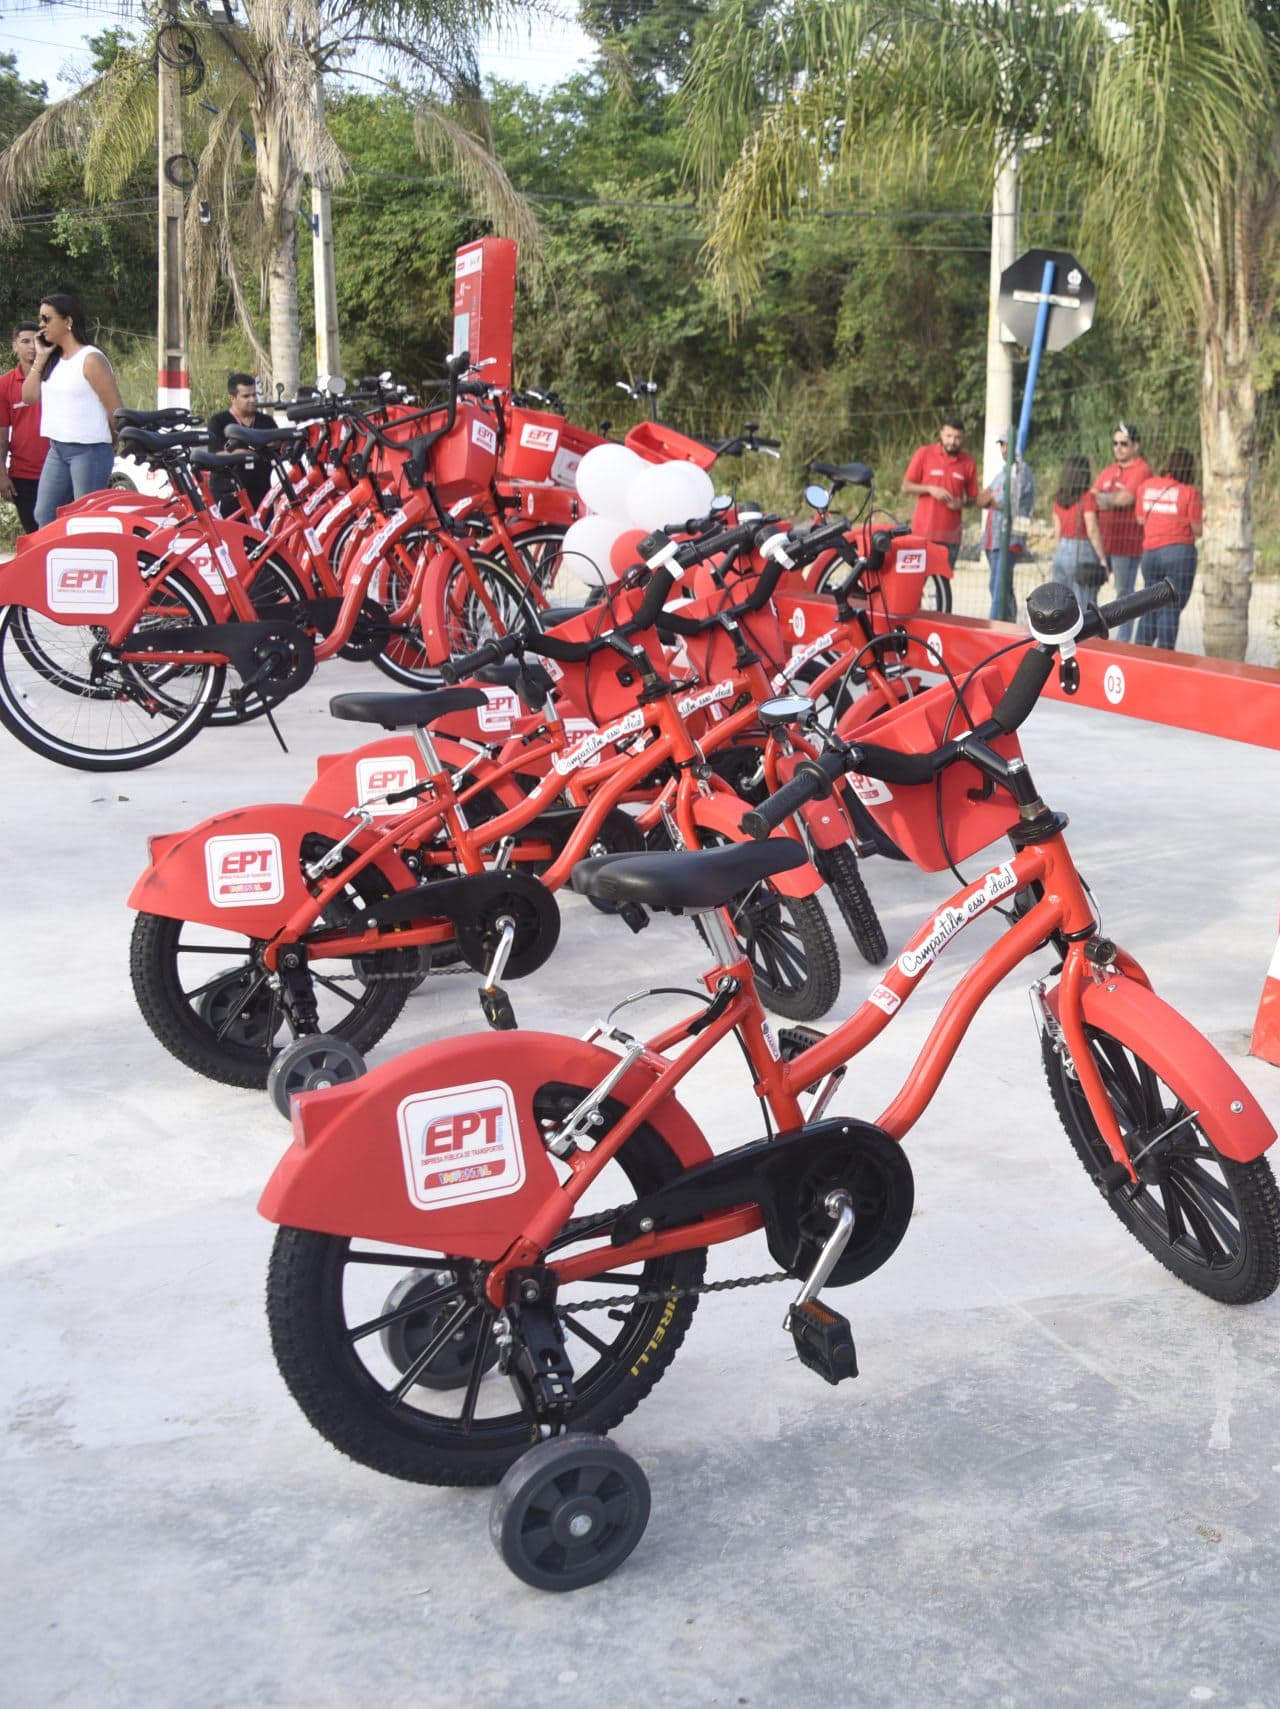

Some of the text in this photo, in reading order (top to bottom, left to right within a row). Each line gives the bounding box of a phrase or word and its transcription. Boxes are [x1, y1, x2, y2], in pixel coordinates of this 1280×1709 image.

[477, 426, 494, 443] EPT
[528, 429, 553, 442] EPT
[58, 568, 109, 588] EPT
[1107, 676, 1122, 693] 03
[485, 695, 514, 711] EPT
[368, 769, 408, 789] EPT
[220, 849, 273, 874] EPT
[902, 867, 1014, 972] Compartilhe essa ideia!
[424, 1105, 503, 1156] EPT
[439, 1165, 491, 1184] INFANTIL
